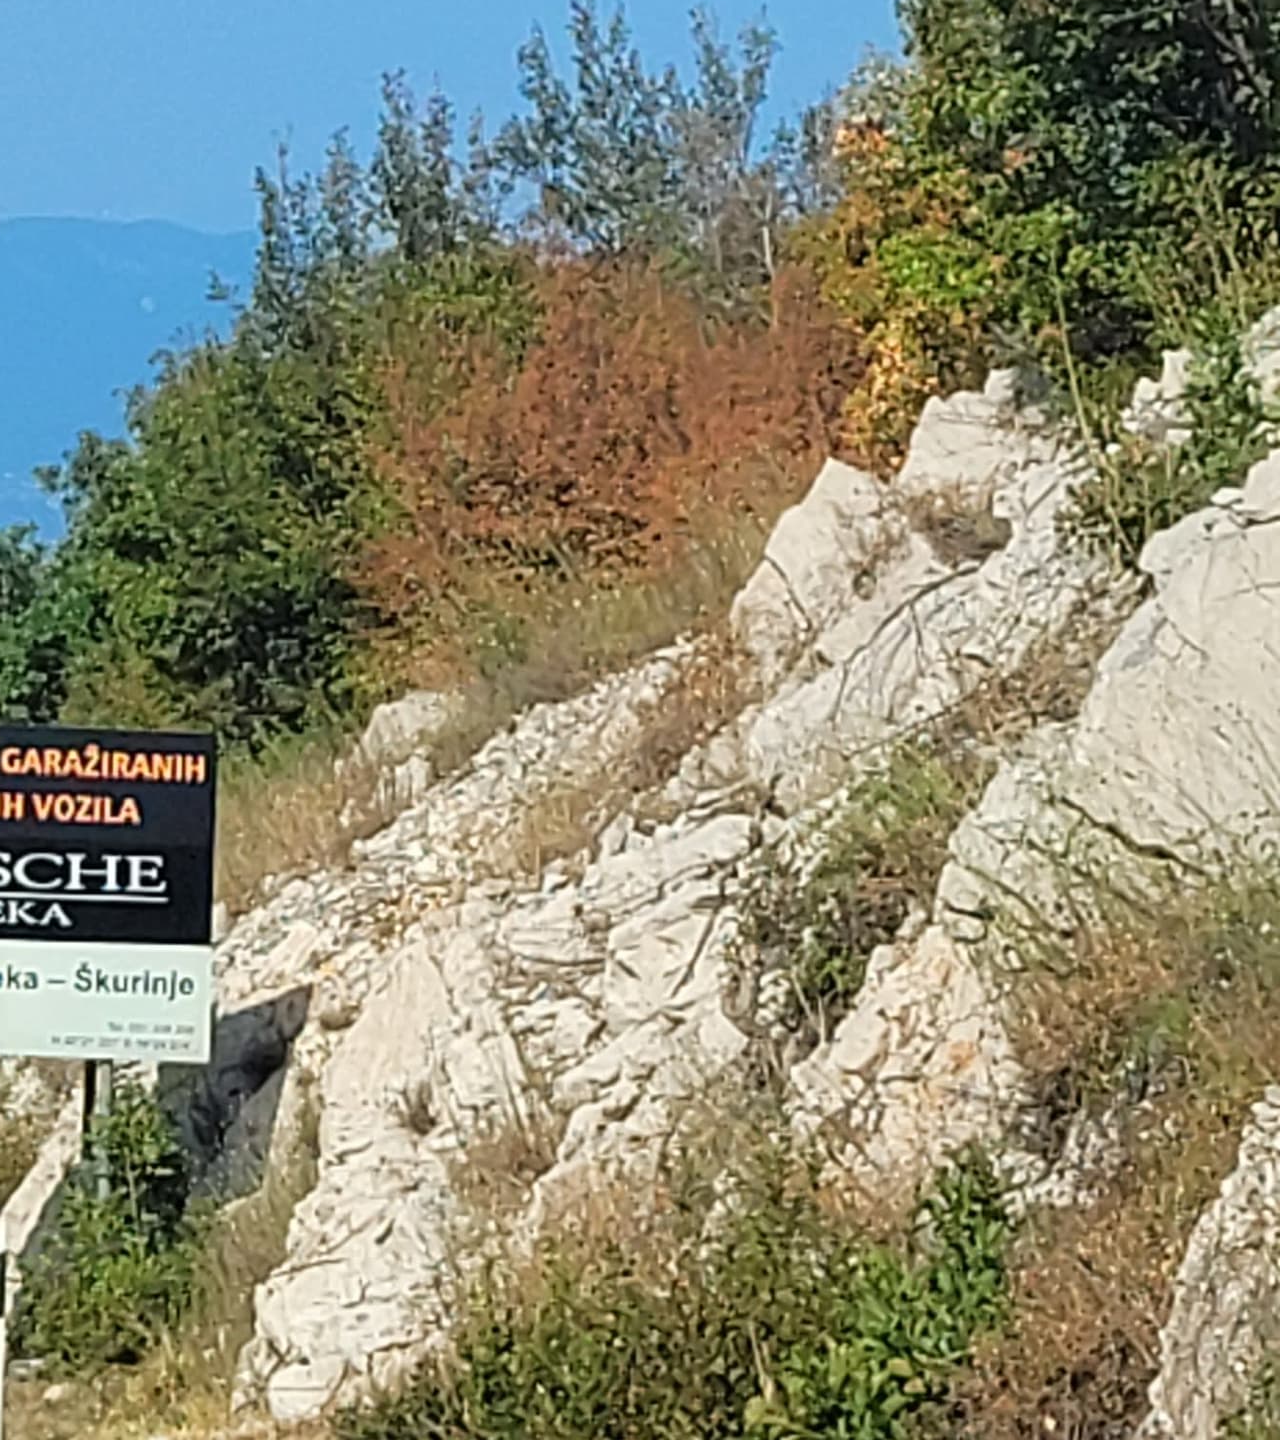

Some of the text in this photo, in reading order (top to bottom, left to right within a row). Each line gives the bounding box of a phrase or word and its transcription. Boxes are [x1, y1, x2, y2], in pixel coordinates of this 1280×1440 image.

[0, 743, 207, 783] GARAŽIRANIH
[31, 793, 142, 825] VOZILA
[73, 962, 195, 1002] Škurinje
